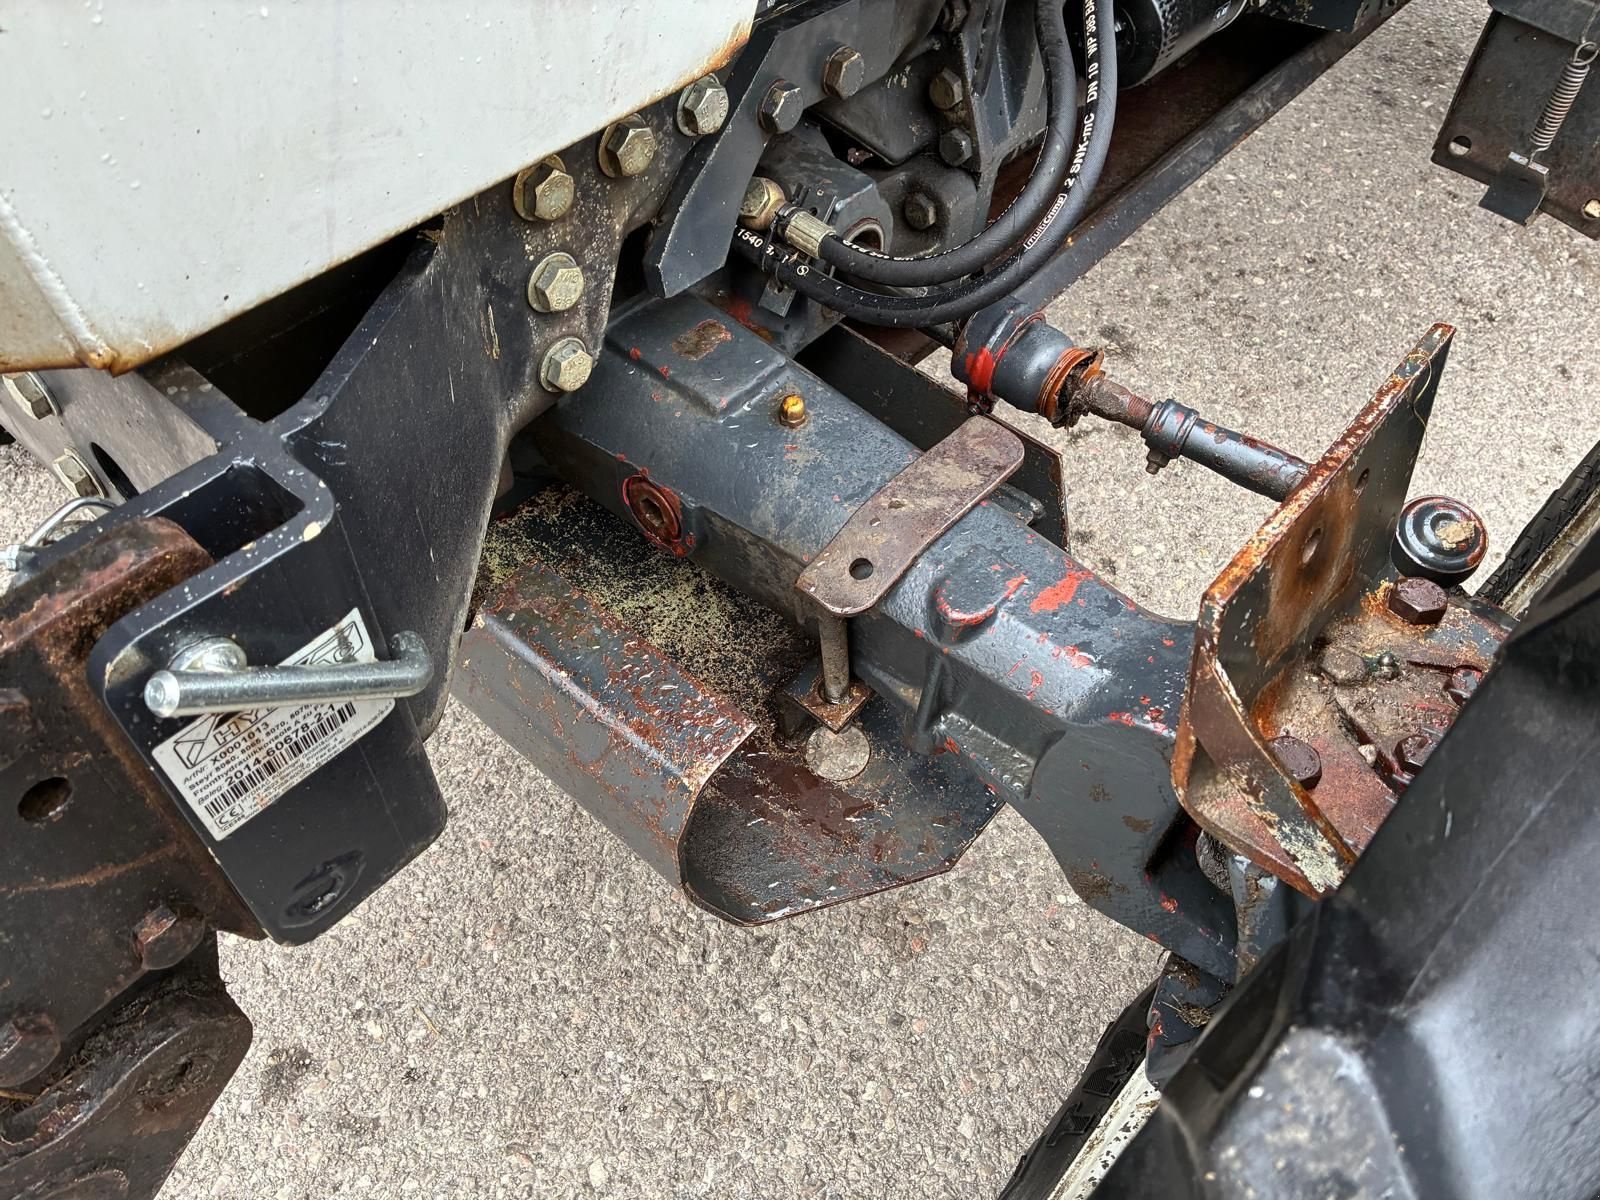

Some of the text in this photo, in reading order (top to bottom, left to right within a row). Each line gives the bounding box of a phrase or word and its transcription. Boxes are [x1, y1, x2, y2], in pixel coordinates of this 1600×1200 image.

[1087, 36, 1098, 59] WP
[1088, 62, 1099, 79] 10
[1087, 80, 1098, 104] DN
[1069, 112, 1095, 175] SNK-mC
[1063, 177, 1075, 189] 2
[1027, 196, 1065, 247] multicrimp
[737, 228, 764, 248] 1540
[210, 720, 269, 765] X0001013
[224, 703, 336, 786] 2014-60678-2-1
[193, 724, 292, 797] Fronthydraulikkonsole
[292, 718, 300, 726] A
[188, 770, 214, 791] Steyr
